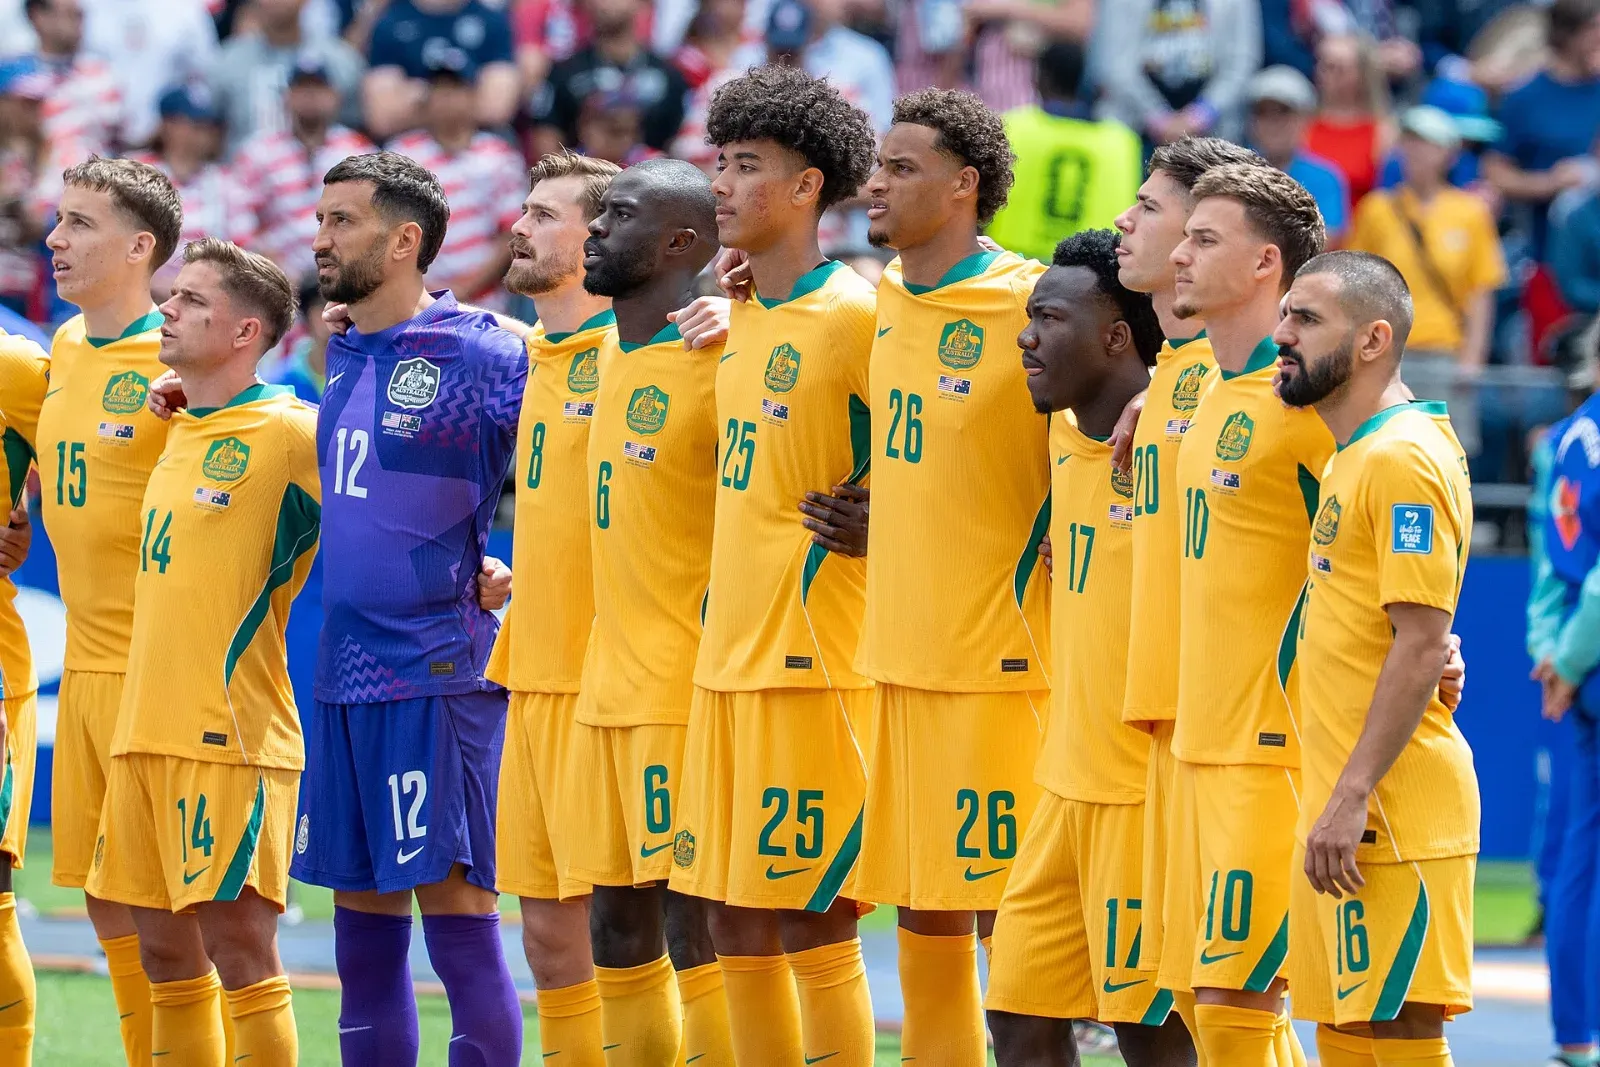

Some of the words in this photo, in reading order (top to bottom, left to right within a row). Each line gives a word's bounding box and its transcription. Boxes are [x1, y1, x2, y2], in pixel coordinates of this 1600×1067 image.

[395, 386, 427, 398] AUSTRALIA
[886, 389, 923, 464] 26
[57, 441, 87, 507] 15
[333, 427, 369, 499] 12
[527, 422, 546, 489] 8
[721, 418, 756, 491] 25
[1134, 444, 1159, 516] 20
[597, 461, 613, 530] 6
[1185, 488, 1209, 559] 10
[142, 509, 172, 574] 14
[1068, 523, 1096, 593] 17
[1400, 533, 1421, 544] PEACE
[177, 793, 214, 864] 14
[388, 770, 427, 841] 12
[644, 765, 671, 834] 6
[758, 787, 824, 858] 25
[956, 789, 1016, 859] 26
[1105, 897, 1142, 968] 17
[1205, 869, 1253, 941] 10
[1336, 900, 1370, 975] 16
